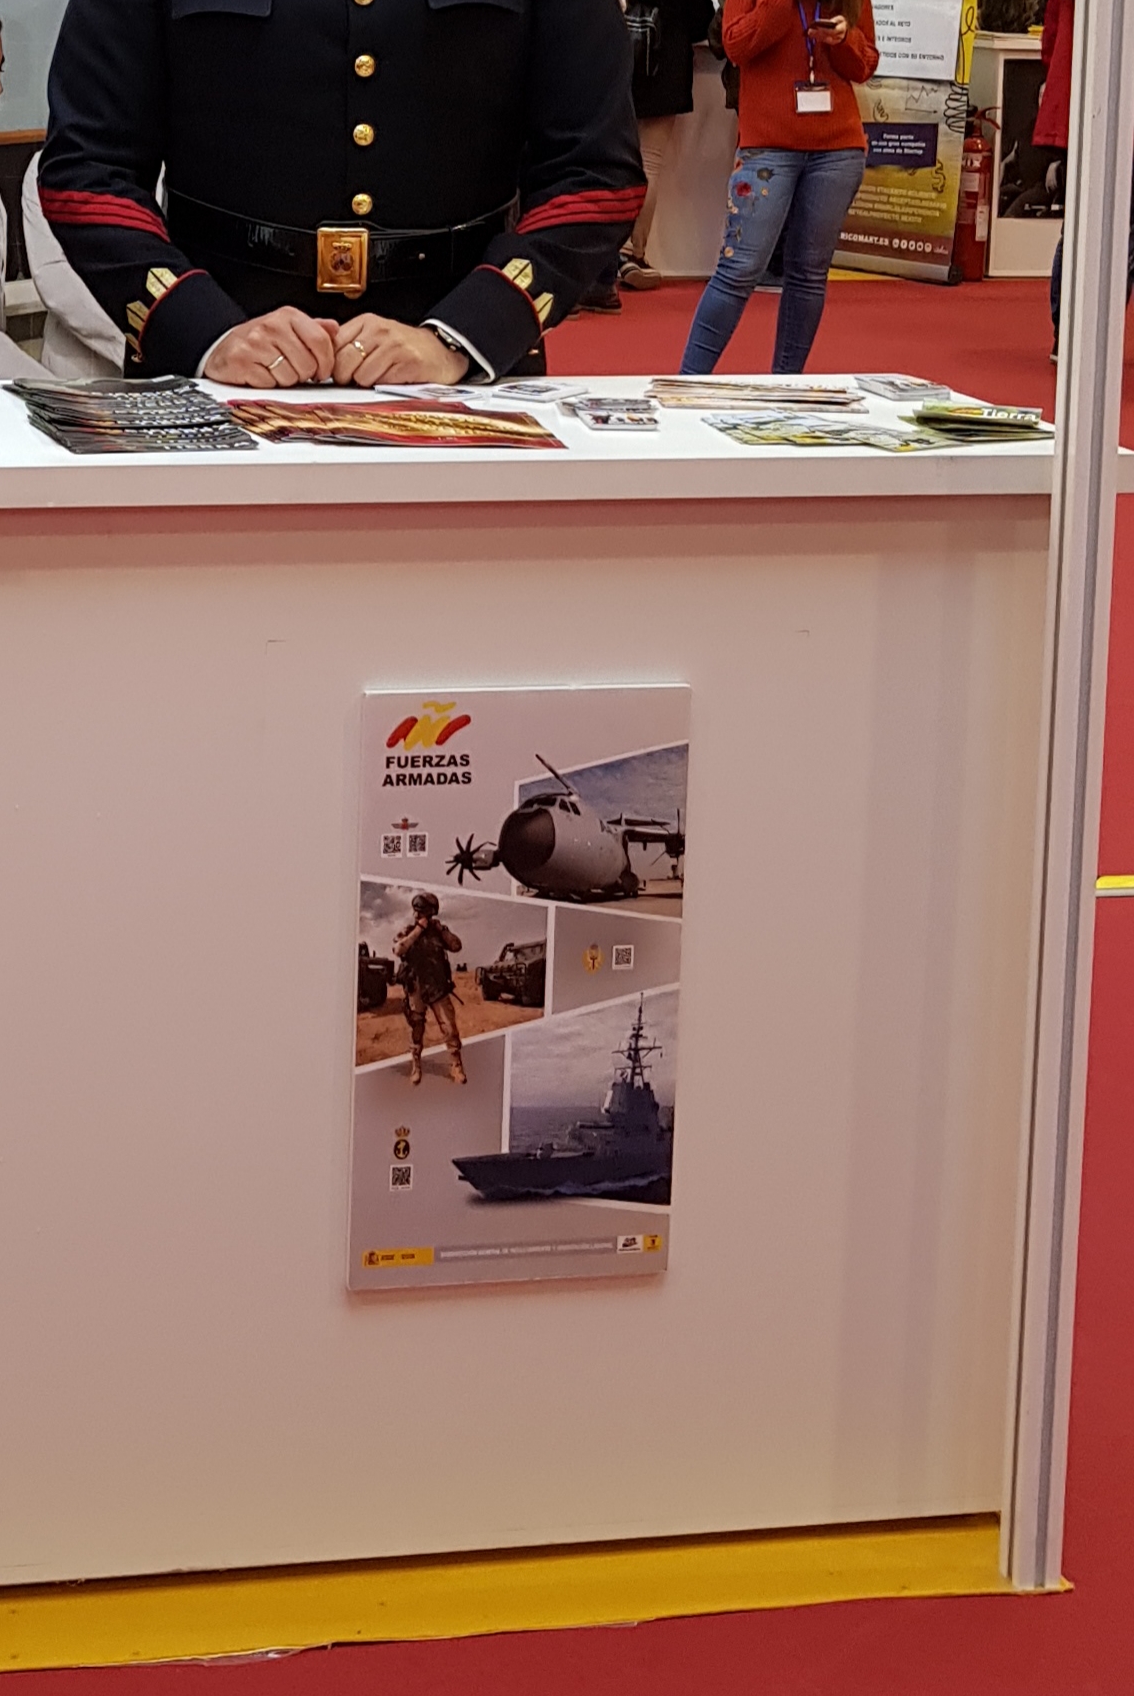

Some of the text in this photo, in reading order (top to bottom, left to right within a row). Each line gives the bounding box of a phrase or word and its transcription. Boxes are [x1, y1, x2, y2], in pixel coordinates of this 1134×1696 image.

[980, 407, 1038, 422] Tierra
[385, 754, 471, 770] FUERZAS
[381, 771, 472, 787] ARMADAS
